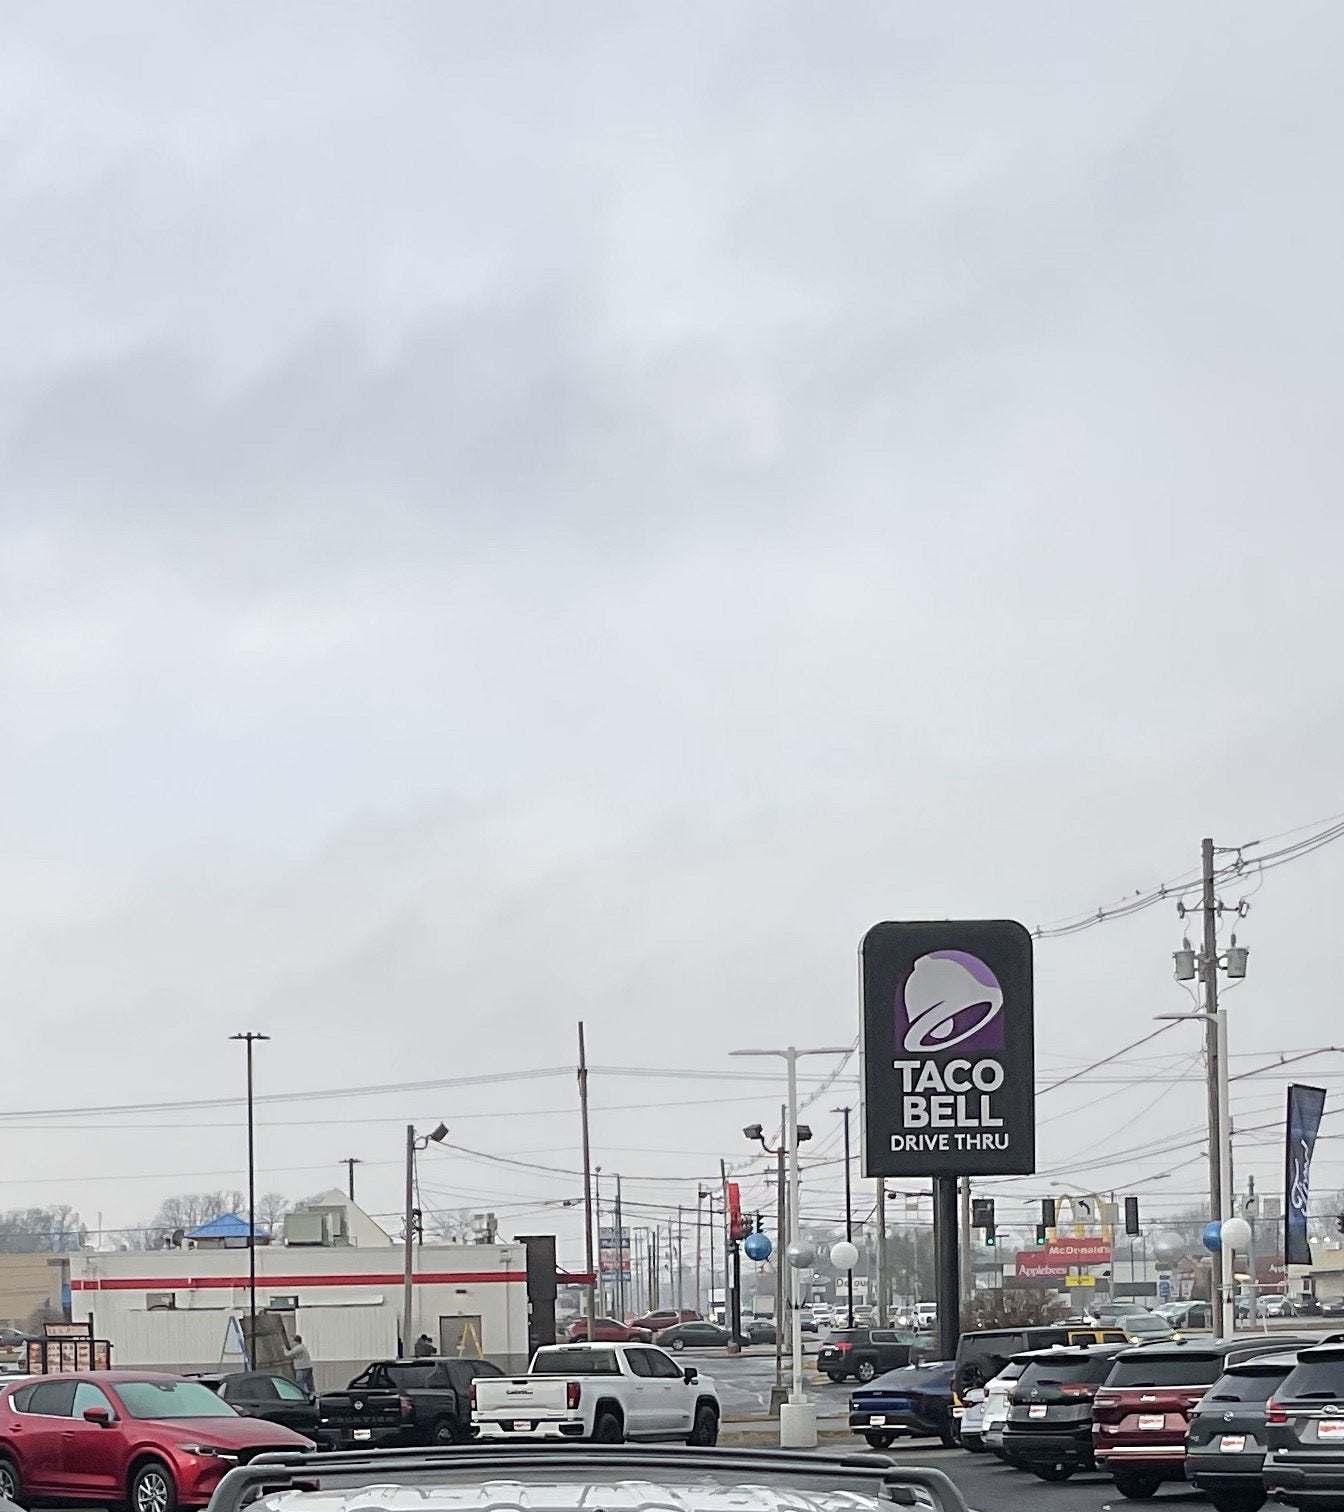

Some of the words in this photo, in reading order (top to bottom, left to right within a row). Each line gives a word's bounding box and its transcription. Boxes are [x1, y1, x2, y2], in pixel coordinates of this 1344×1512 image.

[894, 1059, 1004, 1092] TACO
[903, 1094, 1004, 1128] BELL
[891, 1134, 950, 1151] DRIVE
[954, 1133, 1009, 1150] THRU
